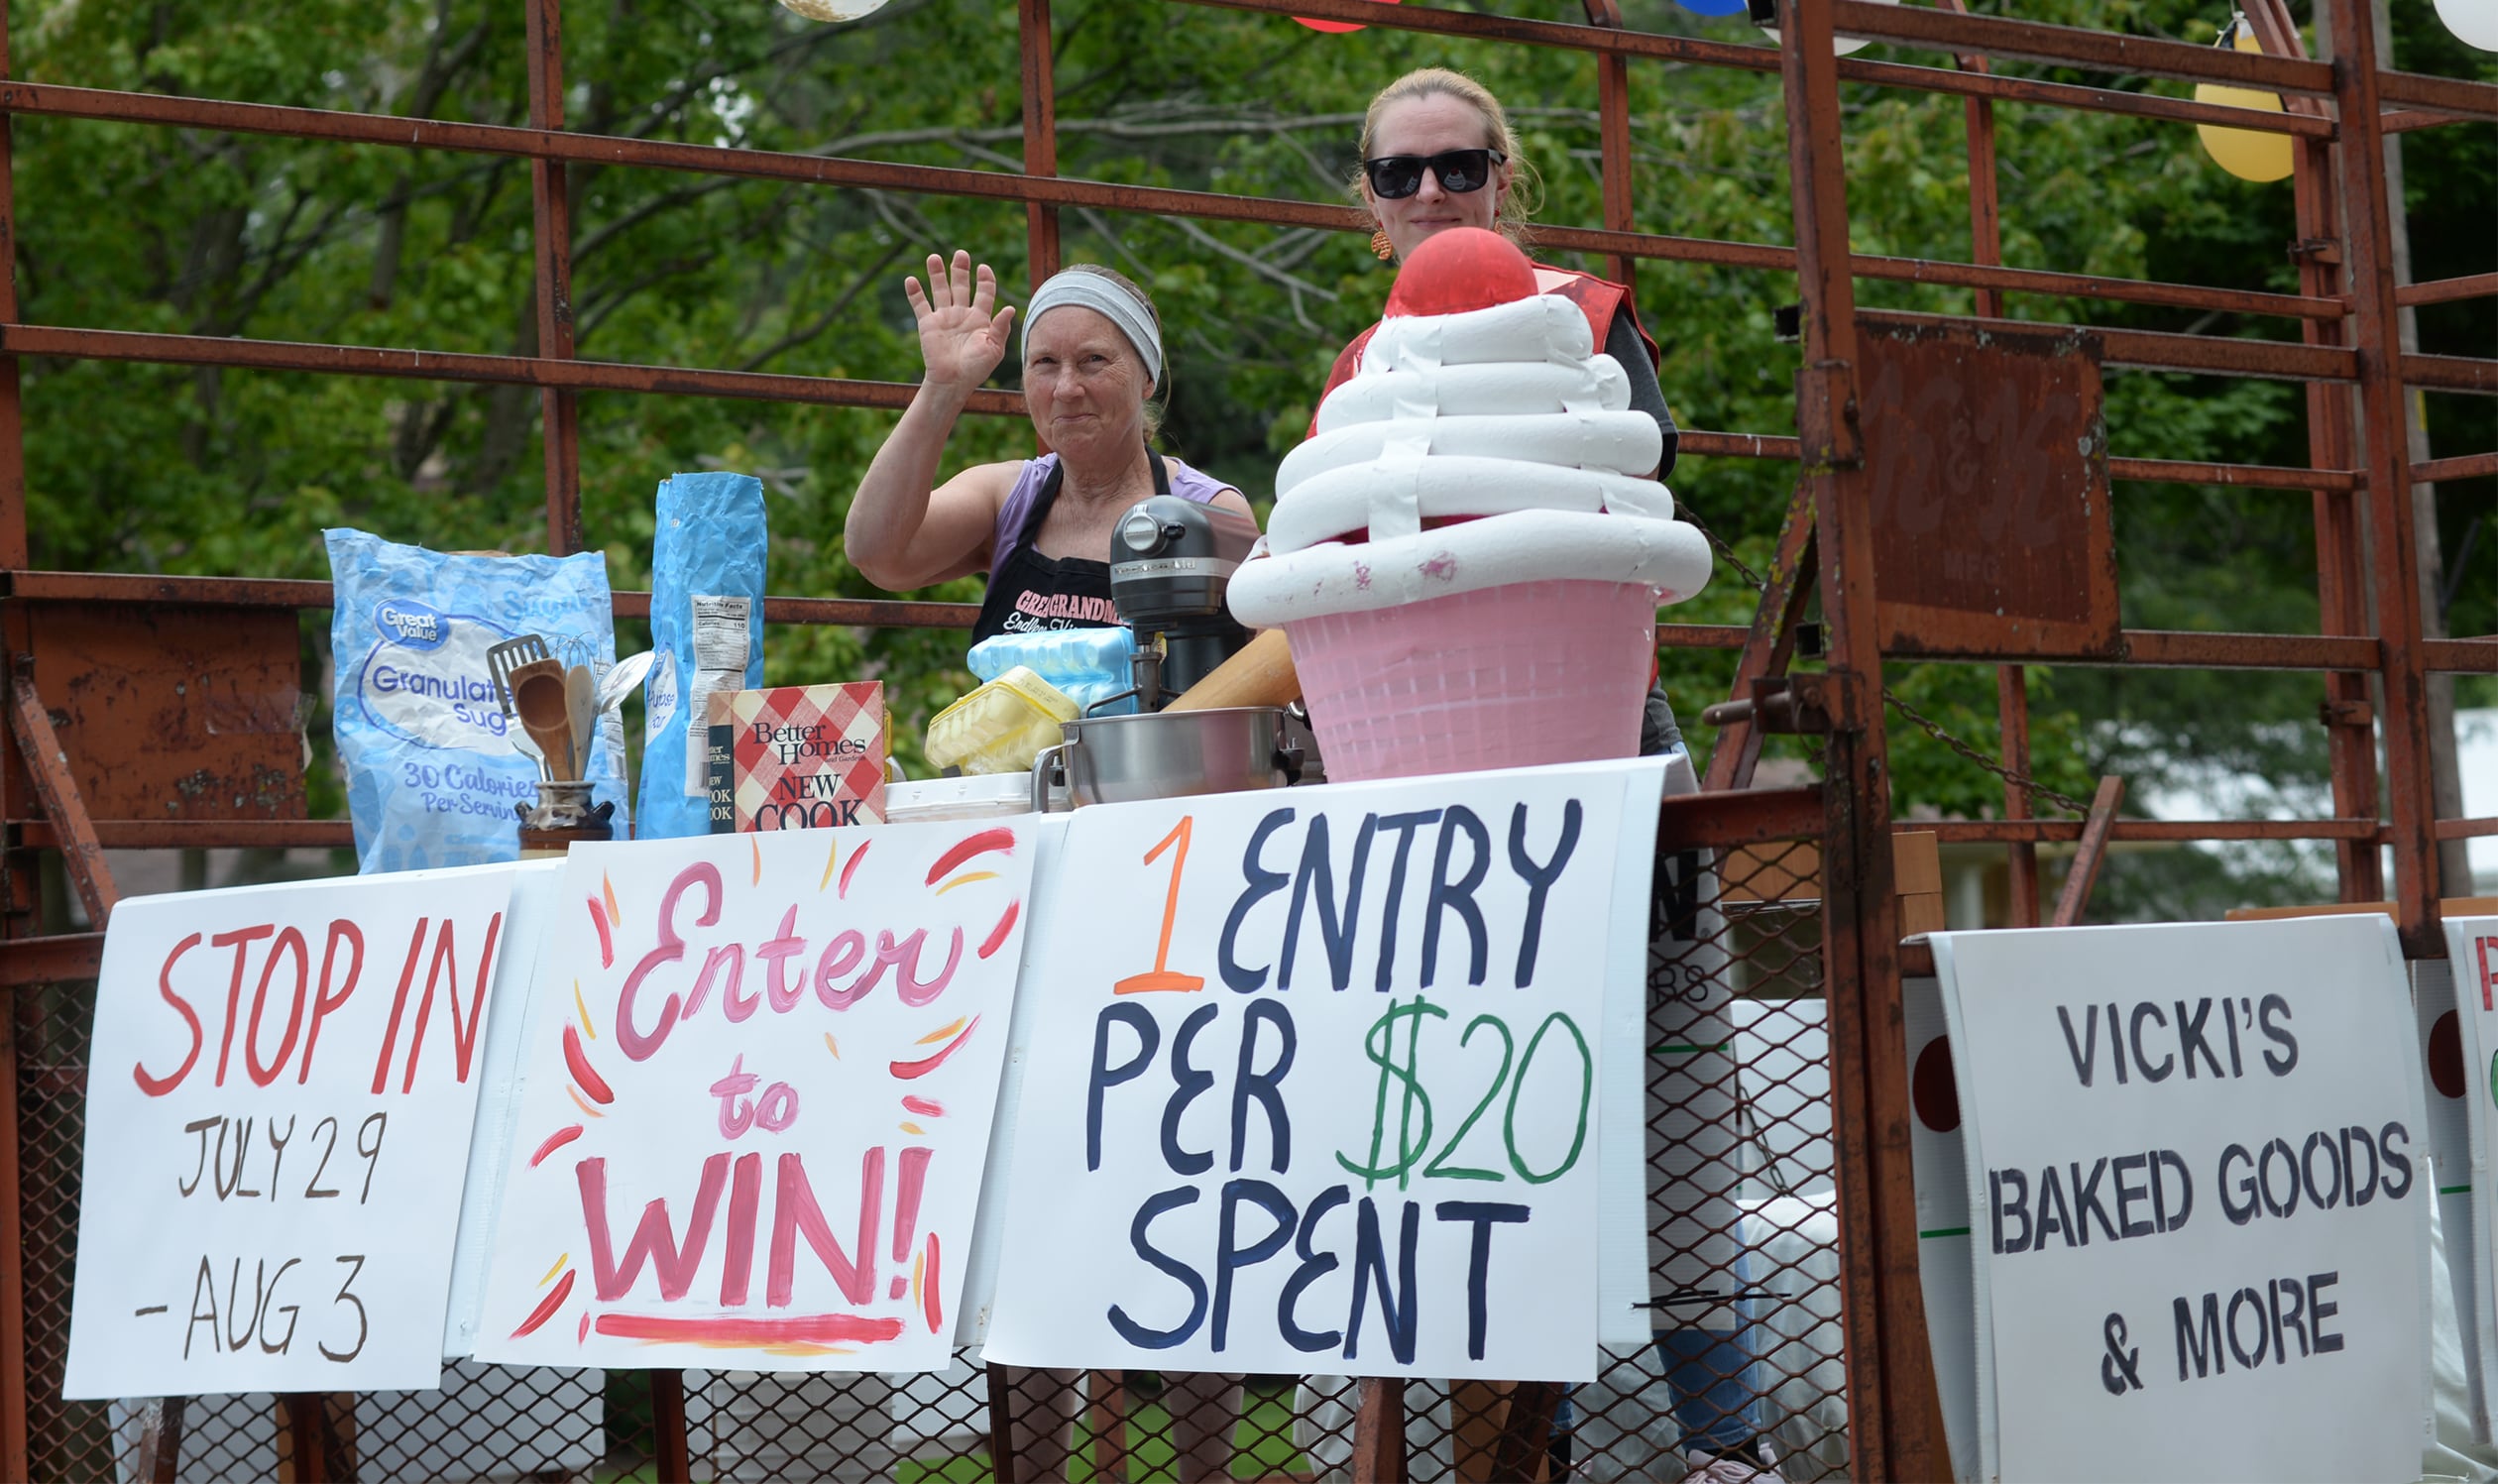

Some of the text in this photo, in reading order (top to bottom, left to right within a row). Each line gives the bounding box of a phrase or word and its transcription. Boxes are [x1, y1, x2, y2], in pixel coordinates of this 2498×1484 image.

[381, 607, 436, 630] Great
[397, 623, 438, 642] Value
[1015, 589, 1126, 626] GREA GRANDM
[454, 703, 508, 736] Sug
[752, 722, 826, 744] Better
[777, 738, 866, 765] Homes
[404, 762, 538, 798] 30 Calories
[420, 791, 519, 822] Per Servin
[709, 775, 723, 786] EW
[754, 799, 864, 832] COOK
[778, 774, 841, 801] NEW
[1112, 798, 1583, 995] 1 ENTRY
[133, 912, 503, 1096] STOP IN
[616, 860, 964, 1063] Enter
[2056, 992, 2299, 1087] VICKI'S
[709, 1053, 801, 1140] to
[1085, 993, 1593, 1192] PER $20
[179, 1111, 388, 1204] JULY 29
[1988, 1120, 2413, 1255] BAKED GOODS
[575, 1146, 936, 1309] WIN!
[1106, 1177, 1531, 1365] SPENT
[184, 1254, 301, 1361] AUG
[317, 1254, 369, 1363] 3
[2101, 1271, 2344, 1397] & MORE
